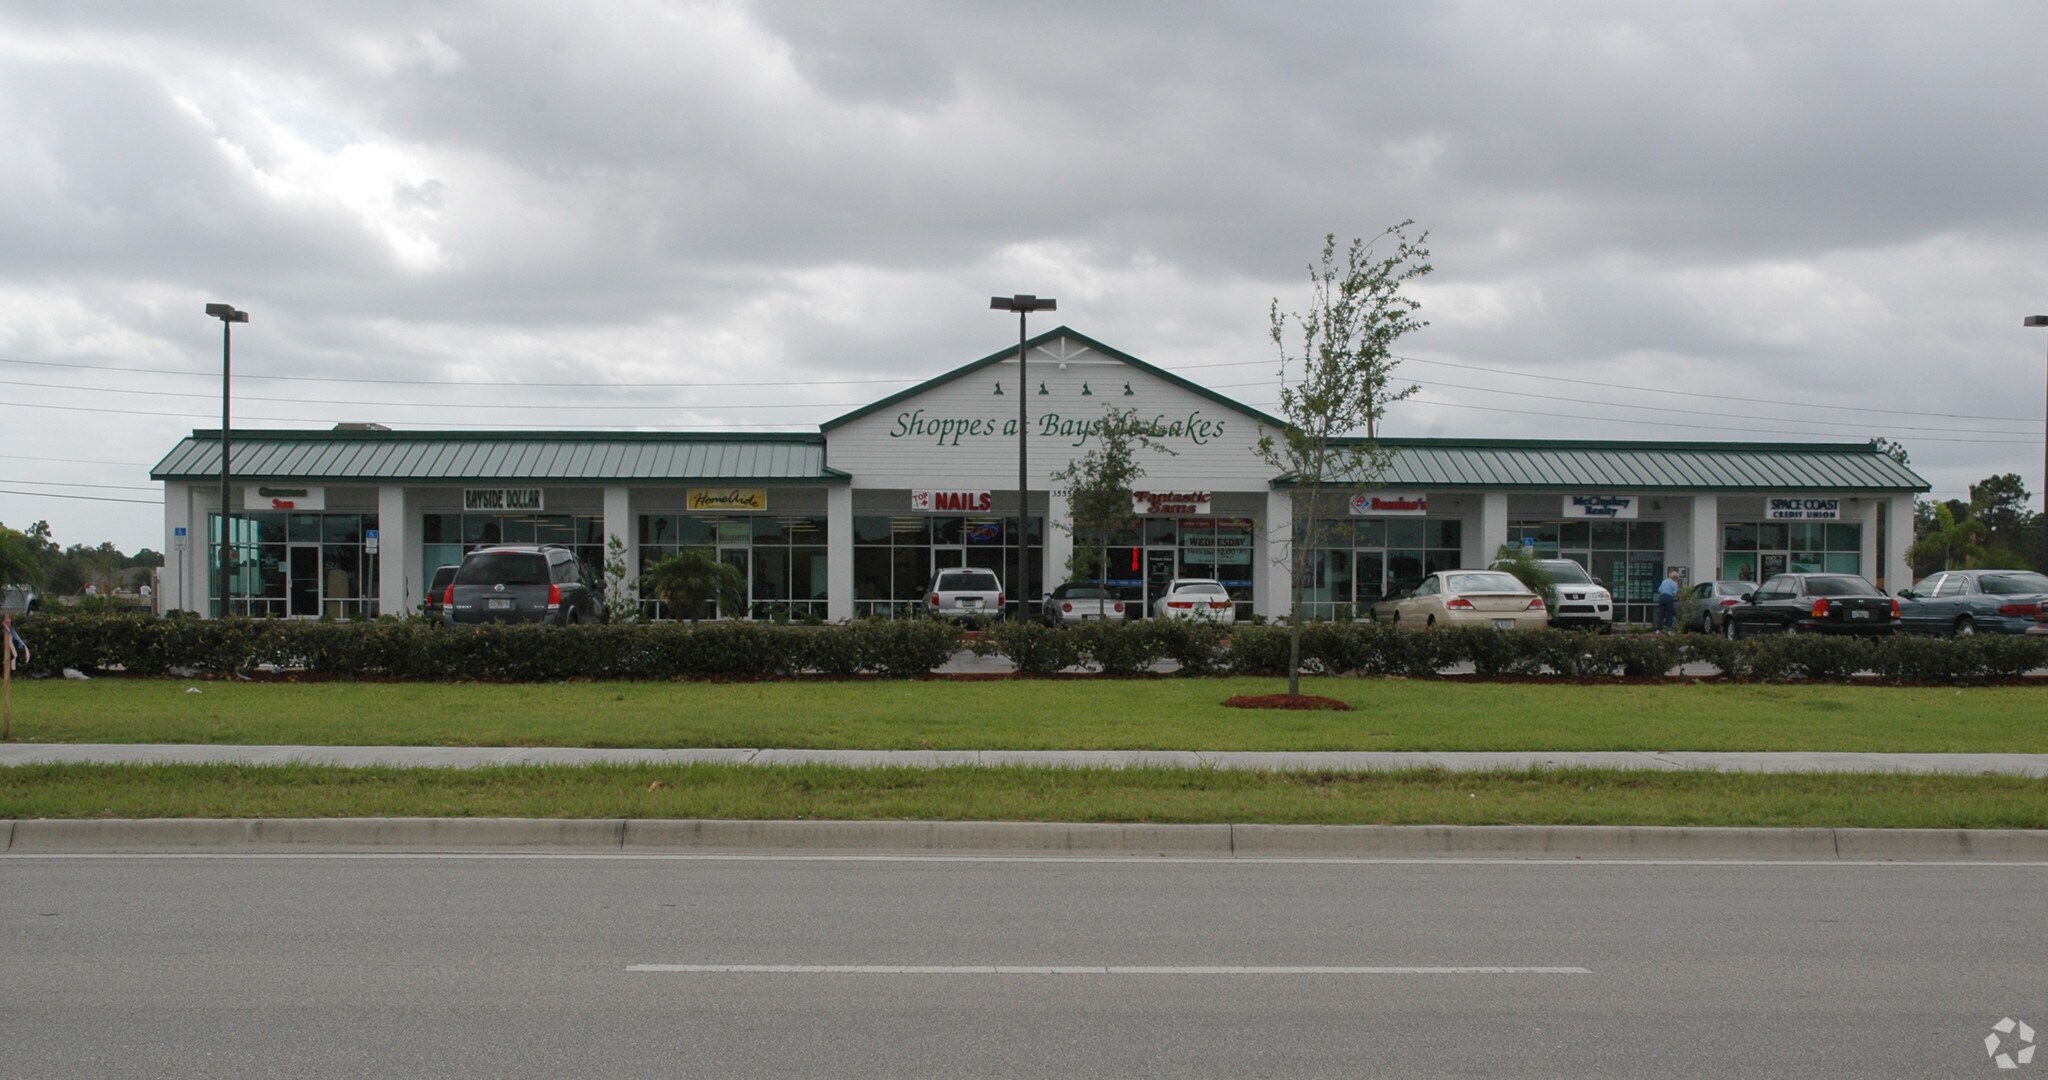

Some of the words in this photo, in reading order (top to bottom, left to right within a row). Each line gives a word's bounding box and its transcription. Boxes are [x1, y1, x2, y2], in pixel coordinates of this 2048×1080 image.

[889, 409, 996, 446] Shoppes
[1147, 410, 1226, 445] Lakes
[465, 489, 503, 508] BAYSIDE
[506, 489, 541, 508] DOLLAR
[913, 492, 928, 501] TOP
[935, 492, 992, 511] NAILS
[1133, 491, 1211, 503] Fantastic
[1147, 501, 1197, 514] Sams
[1371, 496, 1429, 511] Domino's
[1771, 499, 1802, 510] SPACE
[1804, 499, 1839, 510] COAST
[1189, 537, 1246, 547] WEDNESDAY
